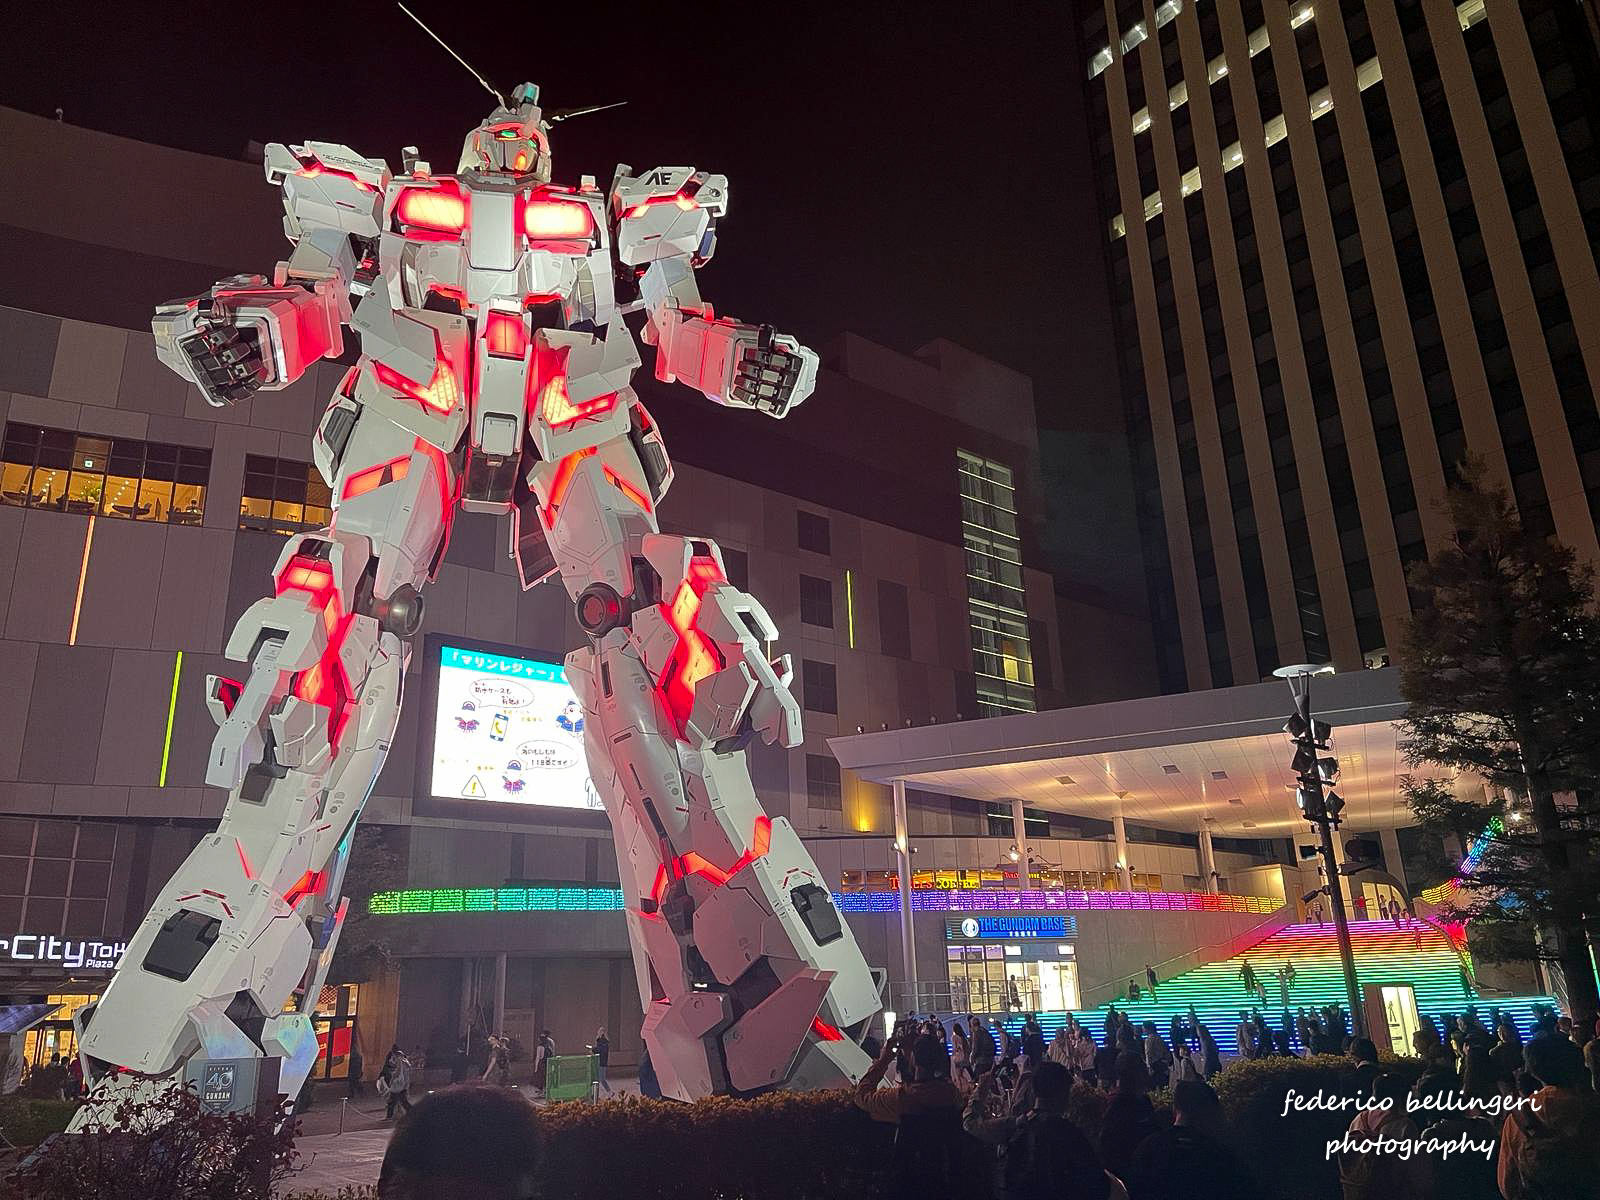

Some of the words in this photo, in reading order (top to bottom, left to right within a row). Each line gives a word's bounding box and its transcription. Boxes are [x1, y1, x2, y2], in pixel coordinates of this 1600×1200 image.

[979, 917, 998, 931] THE
[1000, 917, 1040, 931] GUNDAM
[1041, 917, 1065, 931] BASE
[86, 959, 114, 968] Plaza
